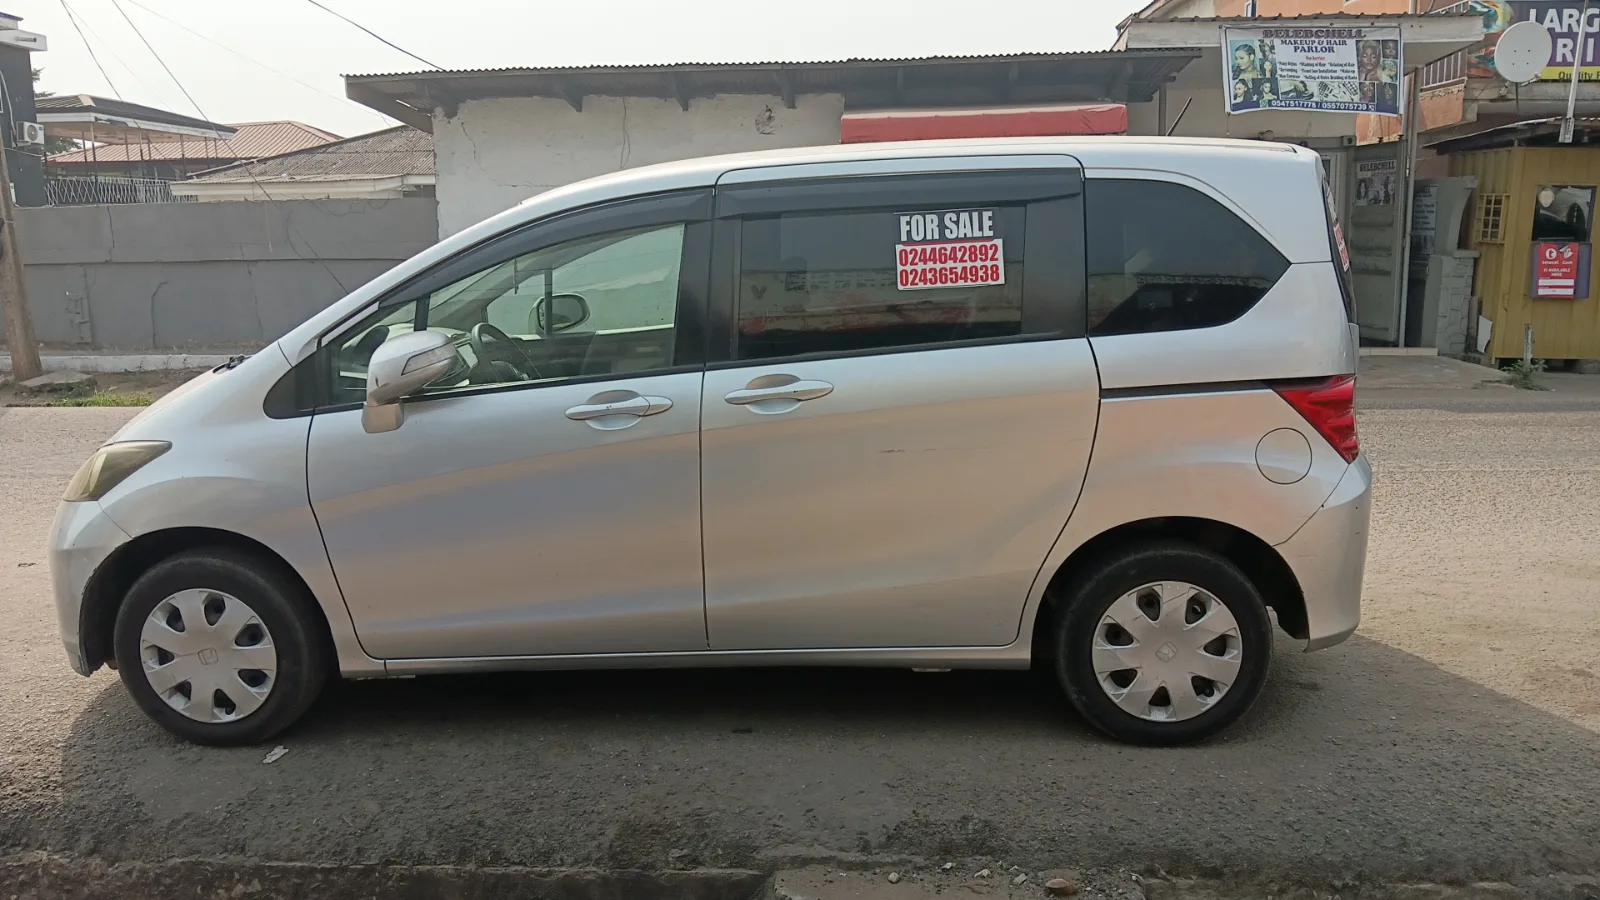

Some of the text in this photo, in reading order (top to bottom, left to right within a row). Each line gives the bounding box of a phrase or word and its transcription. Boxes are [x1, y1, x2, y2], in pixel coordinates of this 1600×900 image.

[1262, 29, 1367, 39] BELEBCHELL
[1293, 45, 1336, 53] PARLOR
[1558, 71, 1594, 81] Qulity
[1271, 99, 1316, 108] 0547517778
[899, 210, 994, 242] FOR SALE
[898, 243, 999, 267] 0244642892
[899, 263, 1000, 287] 0243654938
